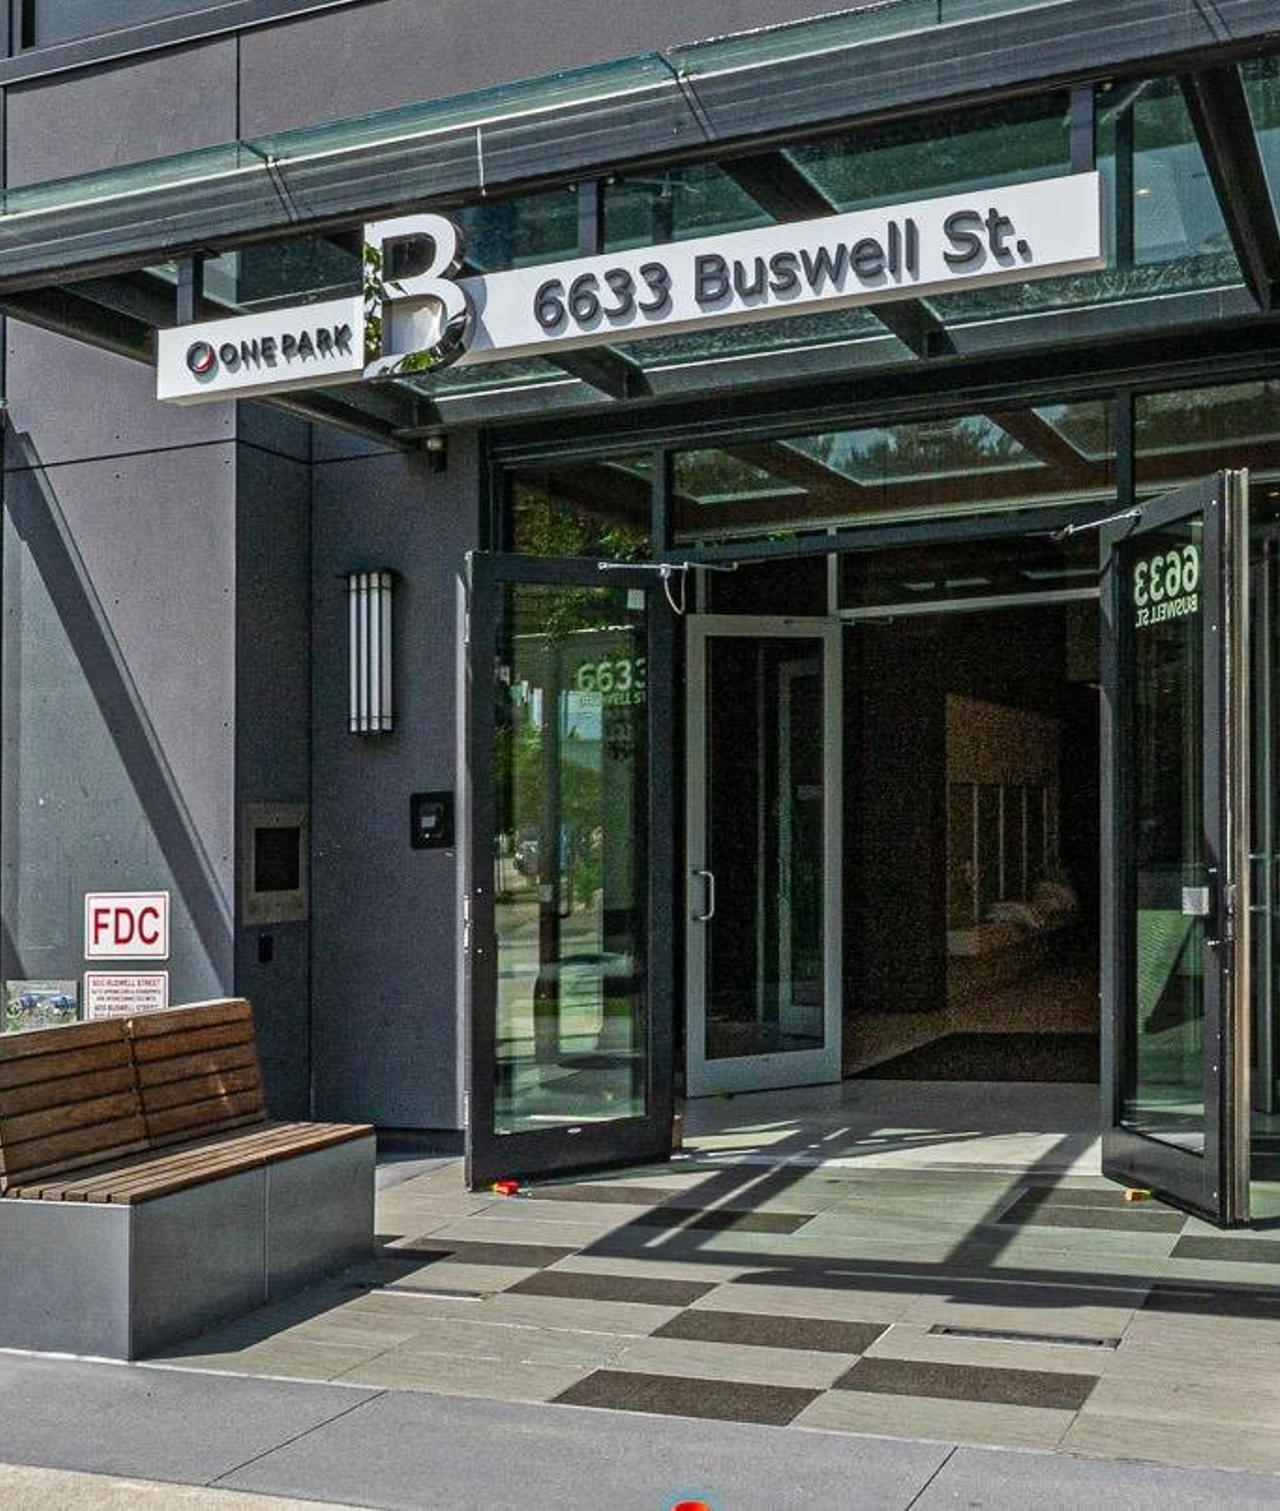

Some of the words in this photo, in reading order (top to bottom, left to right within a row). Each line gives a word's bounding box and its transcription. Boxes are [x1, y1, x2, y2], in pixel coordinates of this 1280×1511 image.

[362, 212, 471, 379] B
[533, 261, 671, 329] 6633
[694, 217, 918, 305] Buswell
[942, 207, 1031, 264] St.
[219, 336, 277, 368] ONE
[281, 323, 353, 360] PARK
[93, 906, 160, 945] FDC
